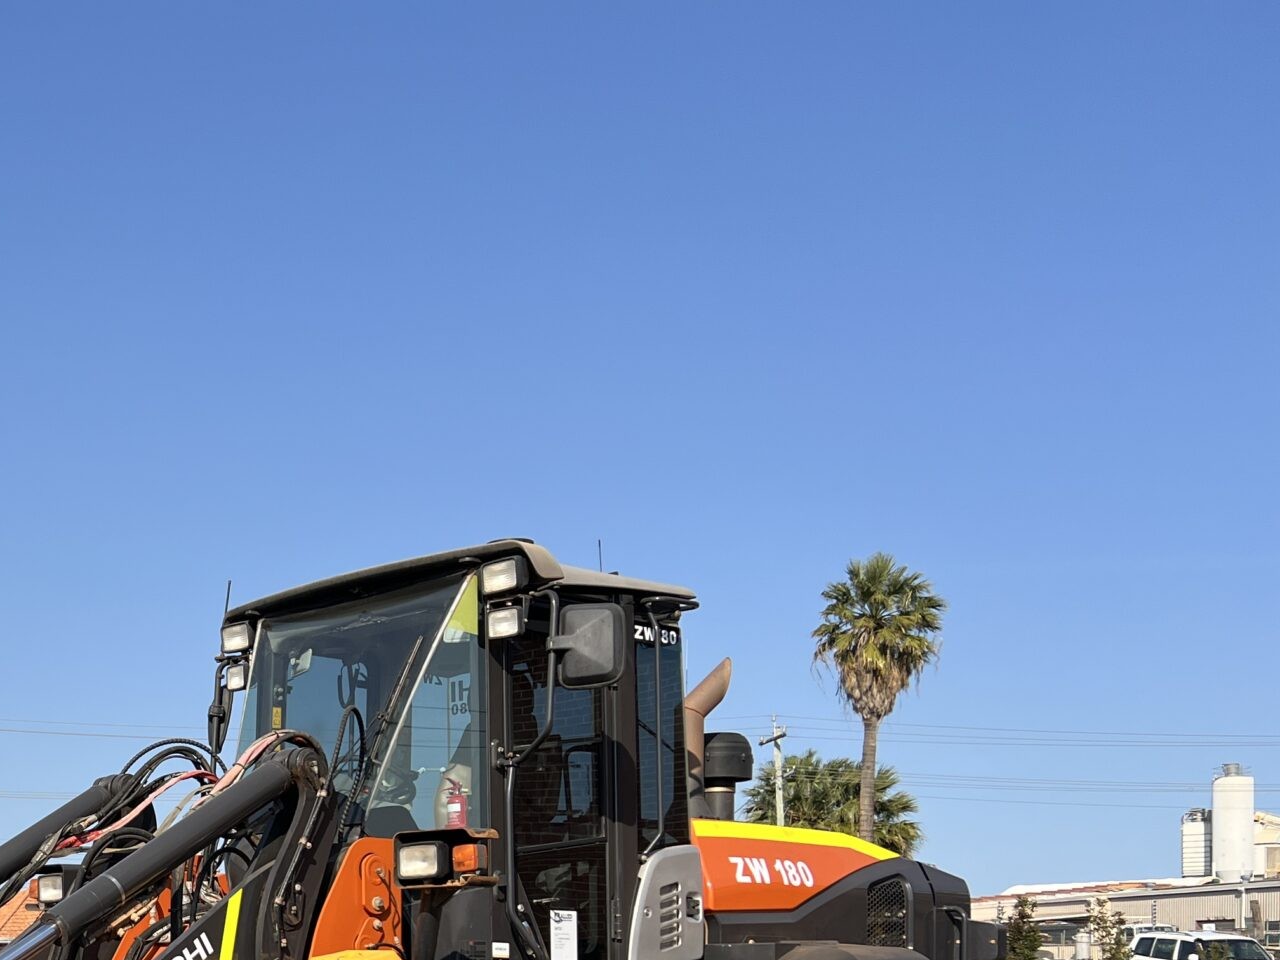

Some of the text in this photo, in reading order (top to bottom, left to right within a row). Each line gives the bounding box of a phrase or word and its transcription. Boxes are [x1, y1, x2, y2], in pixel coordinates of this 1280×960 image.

[634, 625, 656, 641] ZW
[728, 856, 814, 888] ZW 180
